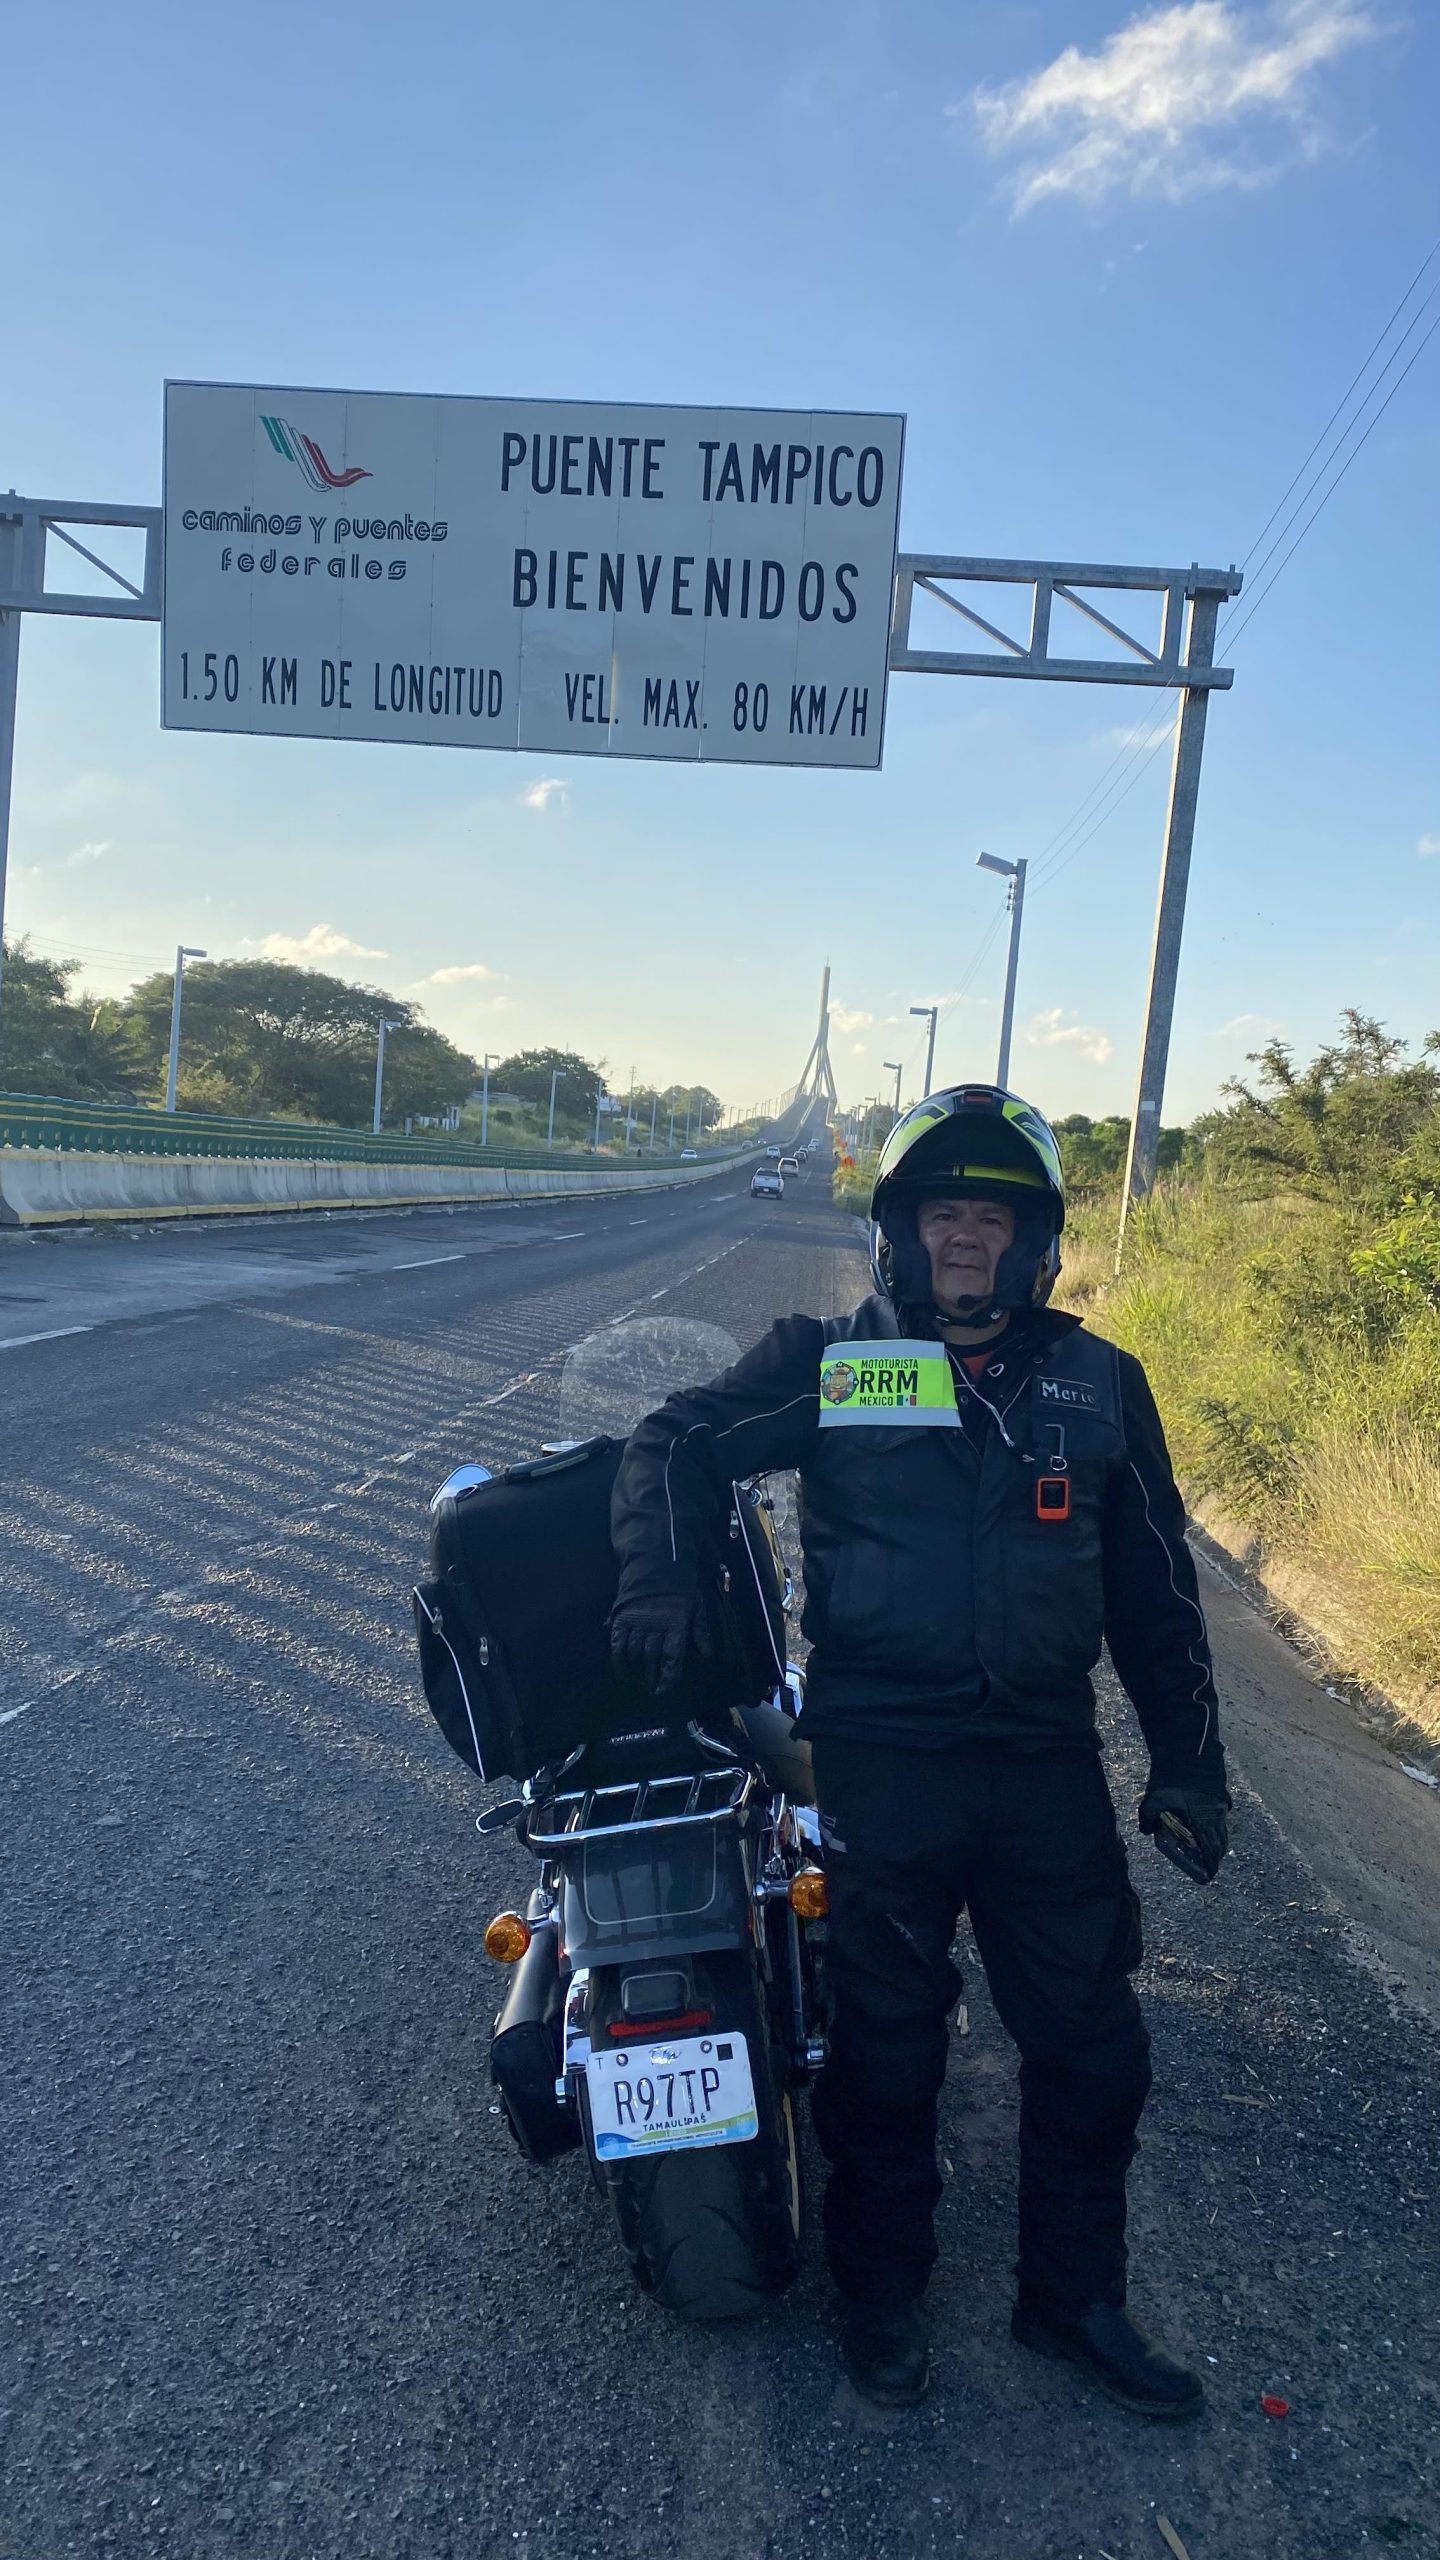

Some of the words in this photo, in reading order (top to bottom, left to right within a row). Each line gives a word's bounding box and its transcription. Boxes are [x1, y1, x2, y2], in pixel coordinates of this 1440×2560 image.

[500, 431, 666, 500] PUENTE
[698, 440, 885, 508] TAMPICO
[181, 505, 303, 537] caminos
[333, 513, 449, 545] puentes
[220, 547, 407, 582] federales
[512, 548, 859, 624] BIENVENIDOS
[180, 651, 239, 703] 1.50
[261, 656, 298, 706] KM
[320, 659, 353, 710] DE
[374, 662, 503, 718] LONGITUD
[564, 672, 619, 726] VEL.
[642, 677, 709, 731] MAX.
[733, 681, 769, 733] 80
[788, 684, 869, 737] KM/H
[859, 1370, 918, 1393] RRM
[861, 1359, 918, 1370] MOTOTURISTA
[613, 2067, 720, 2125] R97TP
[642, 2114, 706, 2132] TAMAULIPAS
